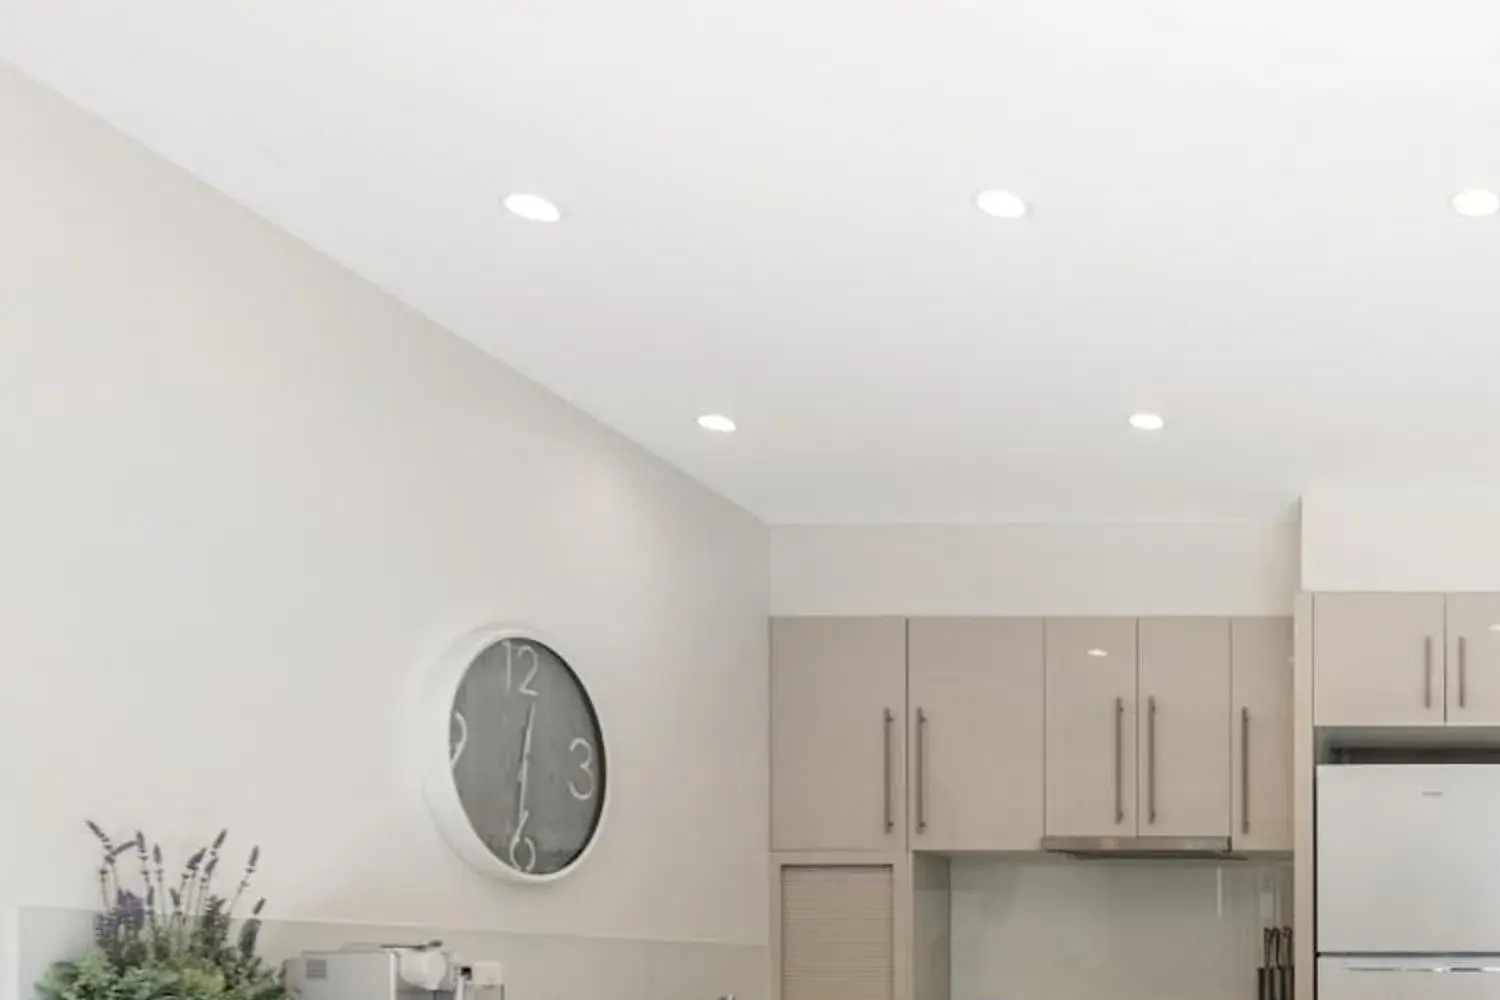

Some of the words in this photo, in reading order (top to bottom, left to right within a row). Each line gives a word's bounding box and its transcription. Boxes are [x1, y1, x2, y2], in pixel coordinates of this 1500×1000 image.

[501, 640, 539, 696] 12
[568, 737, 595, 800] 3
[510, 809, 536, 873] 6
